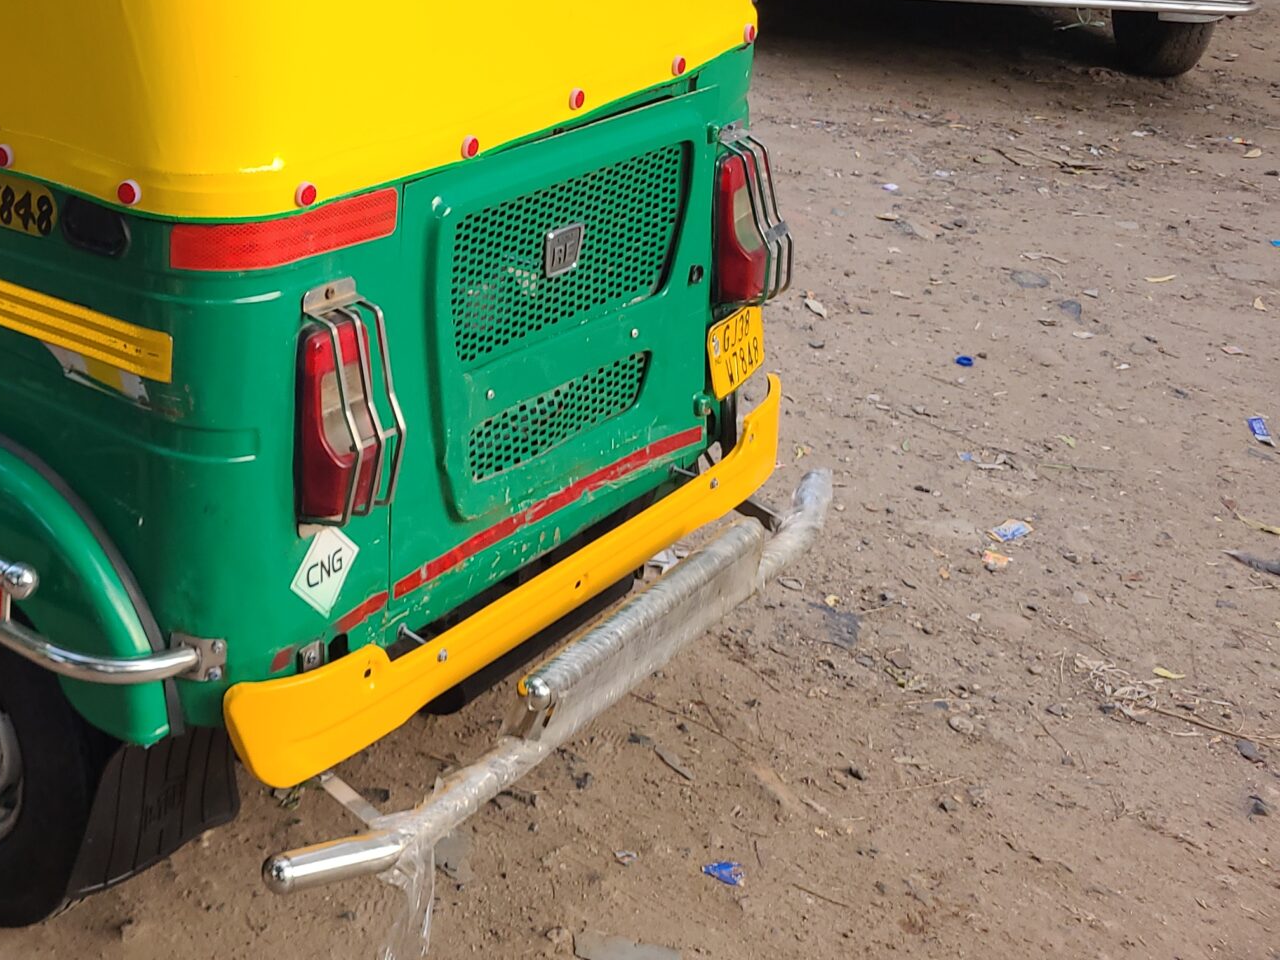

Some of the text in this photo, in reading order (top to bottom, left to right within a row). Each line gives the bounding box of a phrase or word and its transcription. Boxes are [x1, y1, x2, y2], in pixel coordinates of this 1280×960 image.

[723, 308, 751, 353] GJ38
[725, 336, 759, 387] W7848
[306, 546, 343, 588] CNG
